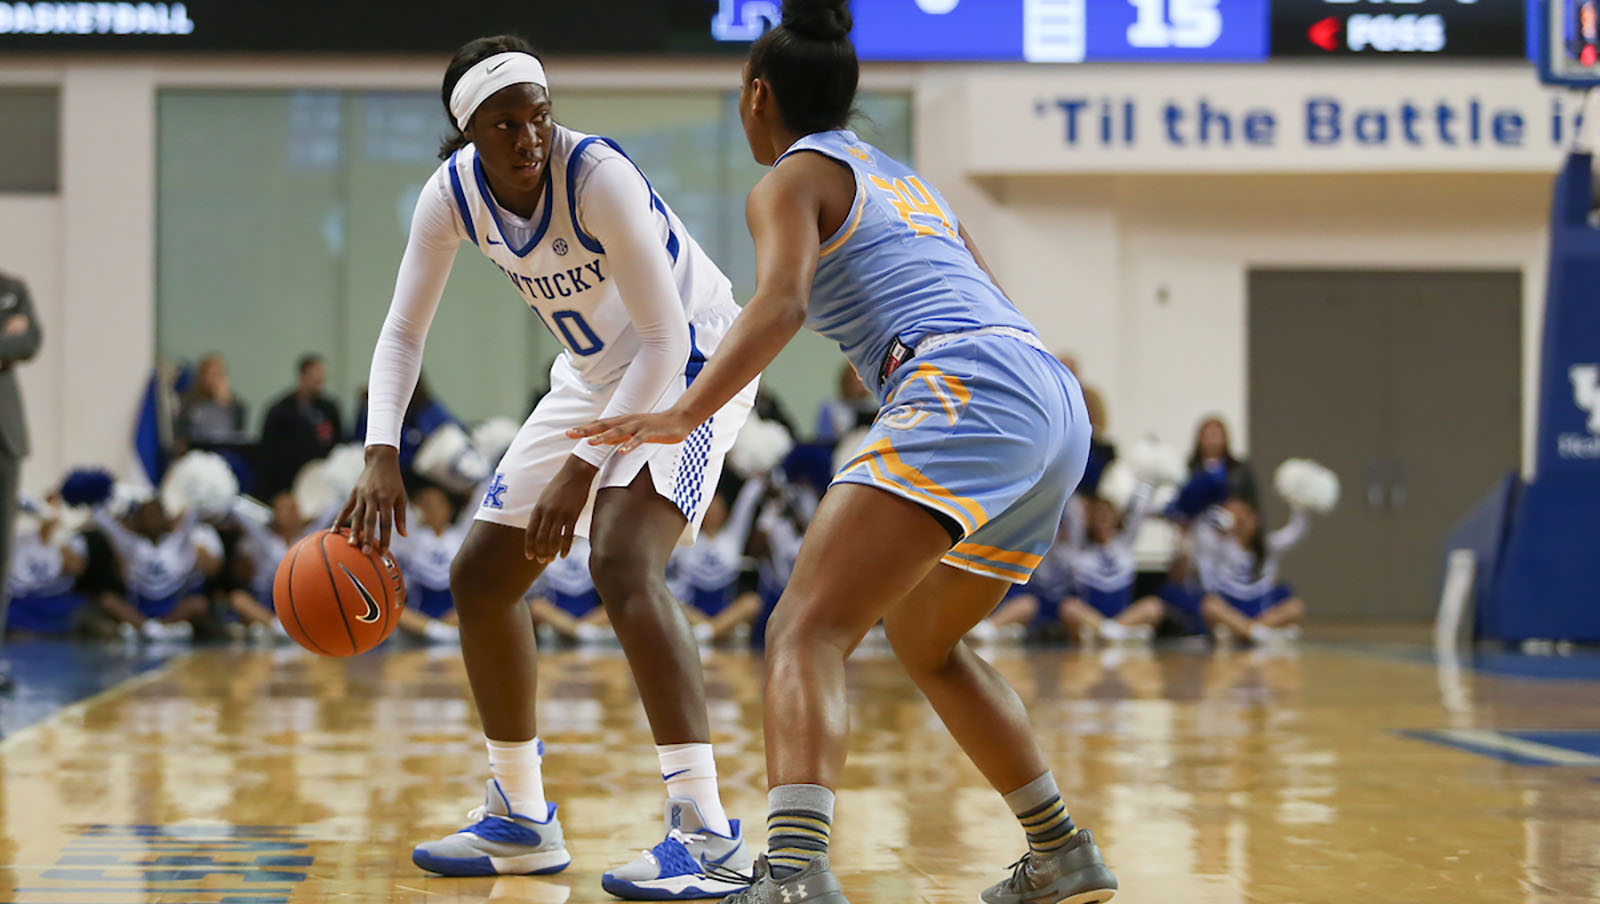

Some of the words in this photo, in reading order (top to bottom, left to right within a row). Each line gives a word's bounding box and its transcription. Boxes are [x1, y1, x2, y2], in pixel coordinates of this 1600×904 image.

[1126, 0, 1224, 48] 15
[1162, 98, 1277, 147] the
[1305, 97, 1527, 147] Battle
[491, 258, 606, 300] NTUCKY
